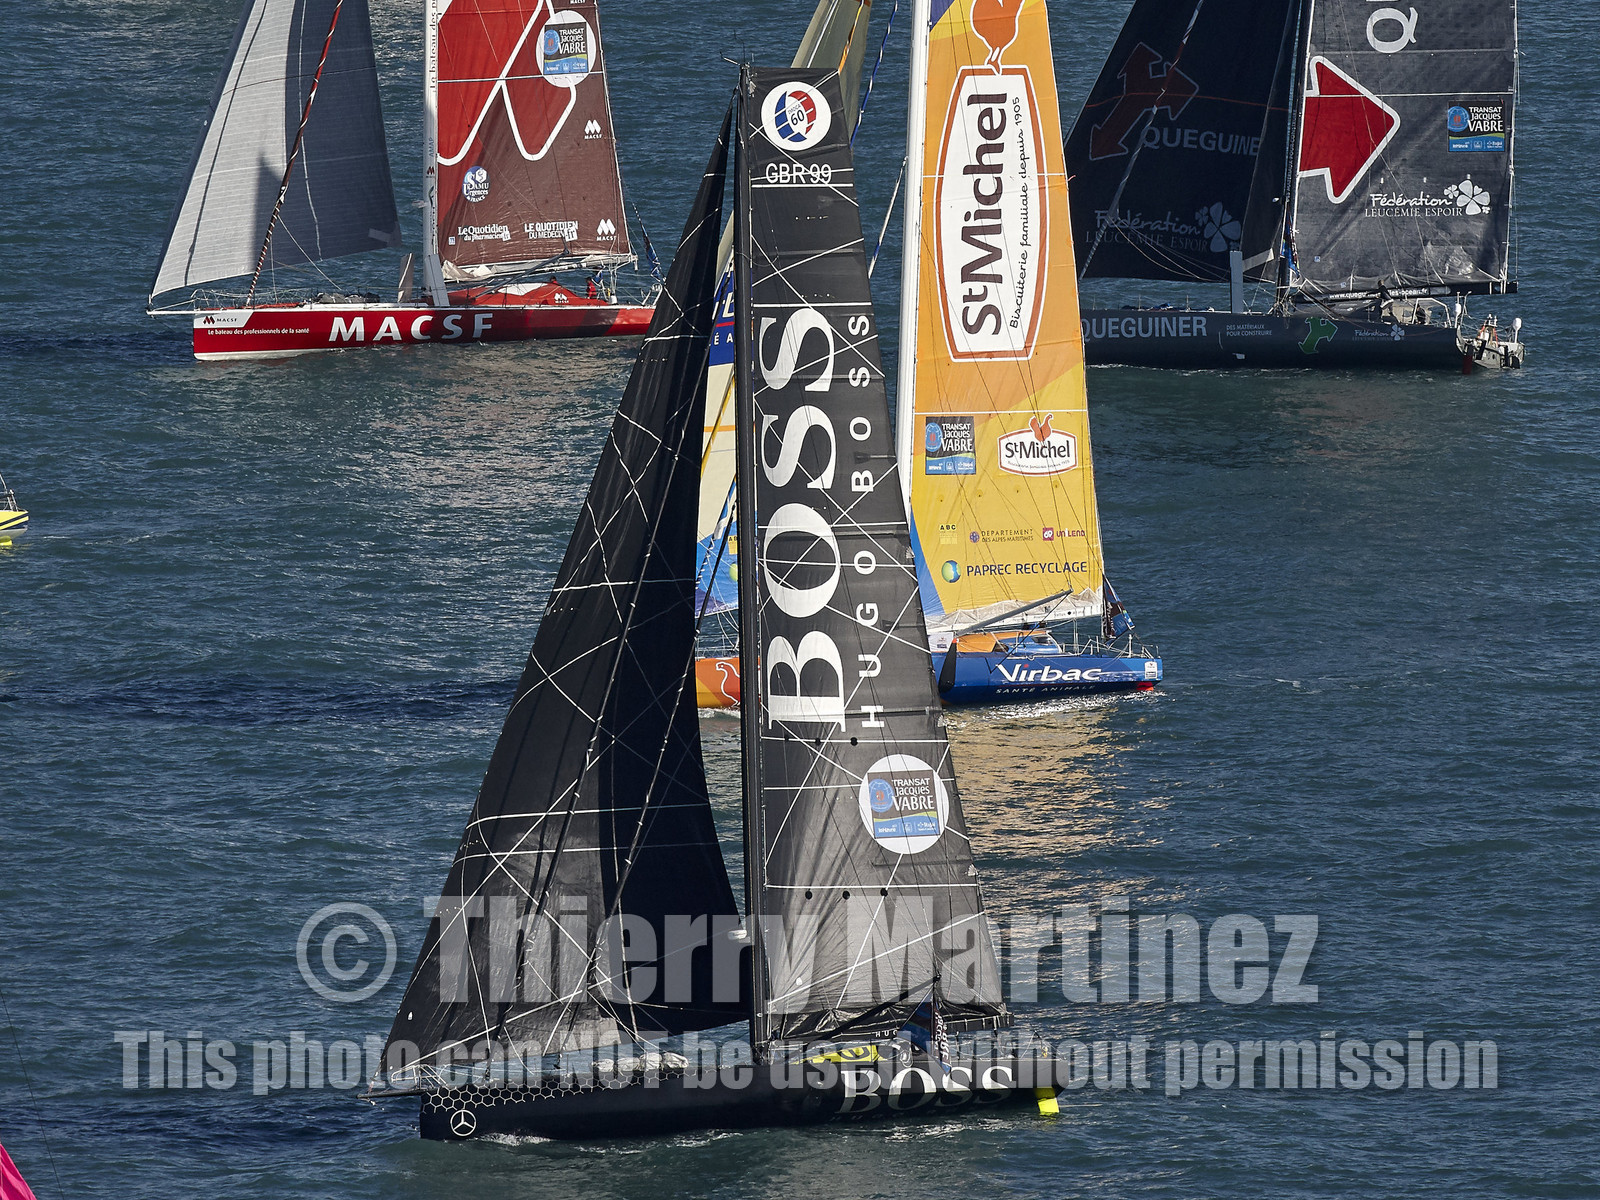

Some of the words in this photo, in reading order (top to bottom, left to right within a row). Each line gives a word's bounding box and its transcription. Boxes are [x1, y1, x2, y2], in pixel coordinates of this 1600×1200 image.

[559, 28, 585, 36] TRANSAT
[557, 41, 586, 54] VABRE
[790, 109, 805, 126] 60
[1012, 96, 1022, 126] 1905
[1467, 120, 1504, 132] VABRE
[1142, 126, 1261, 156] QUEGUINE
[1017, 128, 1030, 179] depuis
[766, 163, 806, 184] GBR
[810, 163, 832, 184] 99
[1370, 191, 1453, 207] Fédération
[1019, 182, 1031, 248] familiale
[1425, 207, 1463, 217] ESPOIR
[524, 223, 535, 233] LE
[535, 220, 578, 232] QUOTIDIEN
[1010, 250, 1028, 329] Biscuiterie
[243, 328, 281, 336] professionnels
[328, 312, 493, 342] MACSF
[847, 314, 874, 493] BOSS
[942, 423, 971, 431] TRANSAT
[941, 438, 973, 452] VABRE
[758, 307, 847, 732] BOSS
[966, 563, 1012, 576] PAPREC
[1015, 561, 1088, 574] RECYCLAGE
[855, 549, 885, 728] HUGO
[995, 663, 1102, 683] Virbac
[891, 777, 931, 787] TRANSAT
[895, 785, 931, 798] Jacques
[891, 794, 935, 812] VABRE
[835, 1065, 1017, 1114] BOSS
